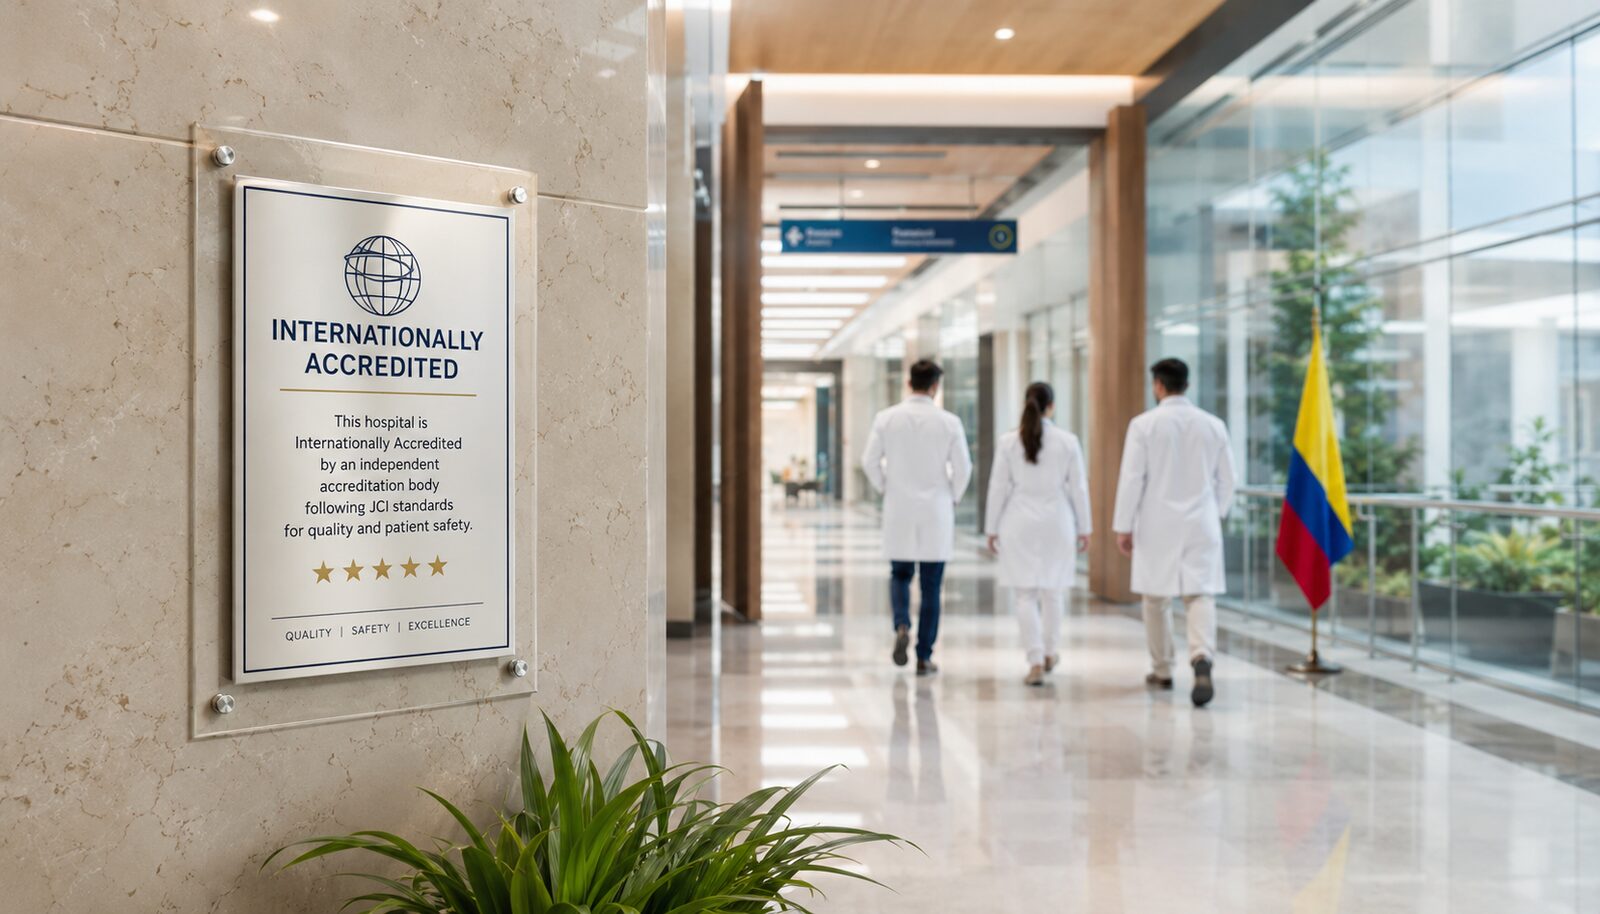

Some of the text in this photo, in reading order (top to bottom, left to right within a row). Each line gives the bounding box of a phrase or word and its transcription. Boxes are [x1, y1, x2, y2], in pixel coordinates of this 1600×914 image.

[272, 318, 484, 351] INTERNATIONALLY
[304, 352, 458, 379] ACCREDITED
[334, 414, 428, 431] This hospital is
[295, 436, 462, 452] Internationally Accredited
[320, 458, 440, 473] by an independent
[320, 478, 440, 493] accreditation body
[305, 498, 454, 516] following JCI standards
[284, 519, 473, 540] for quality and patient safety.
[285, 617, 470, 642] QUALITY SAFETY EXCELLENCE
